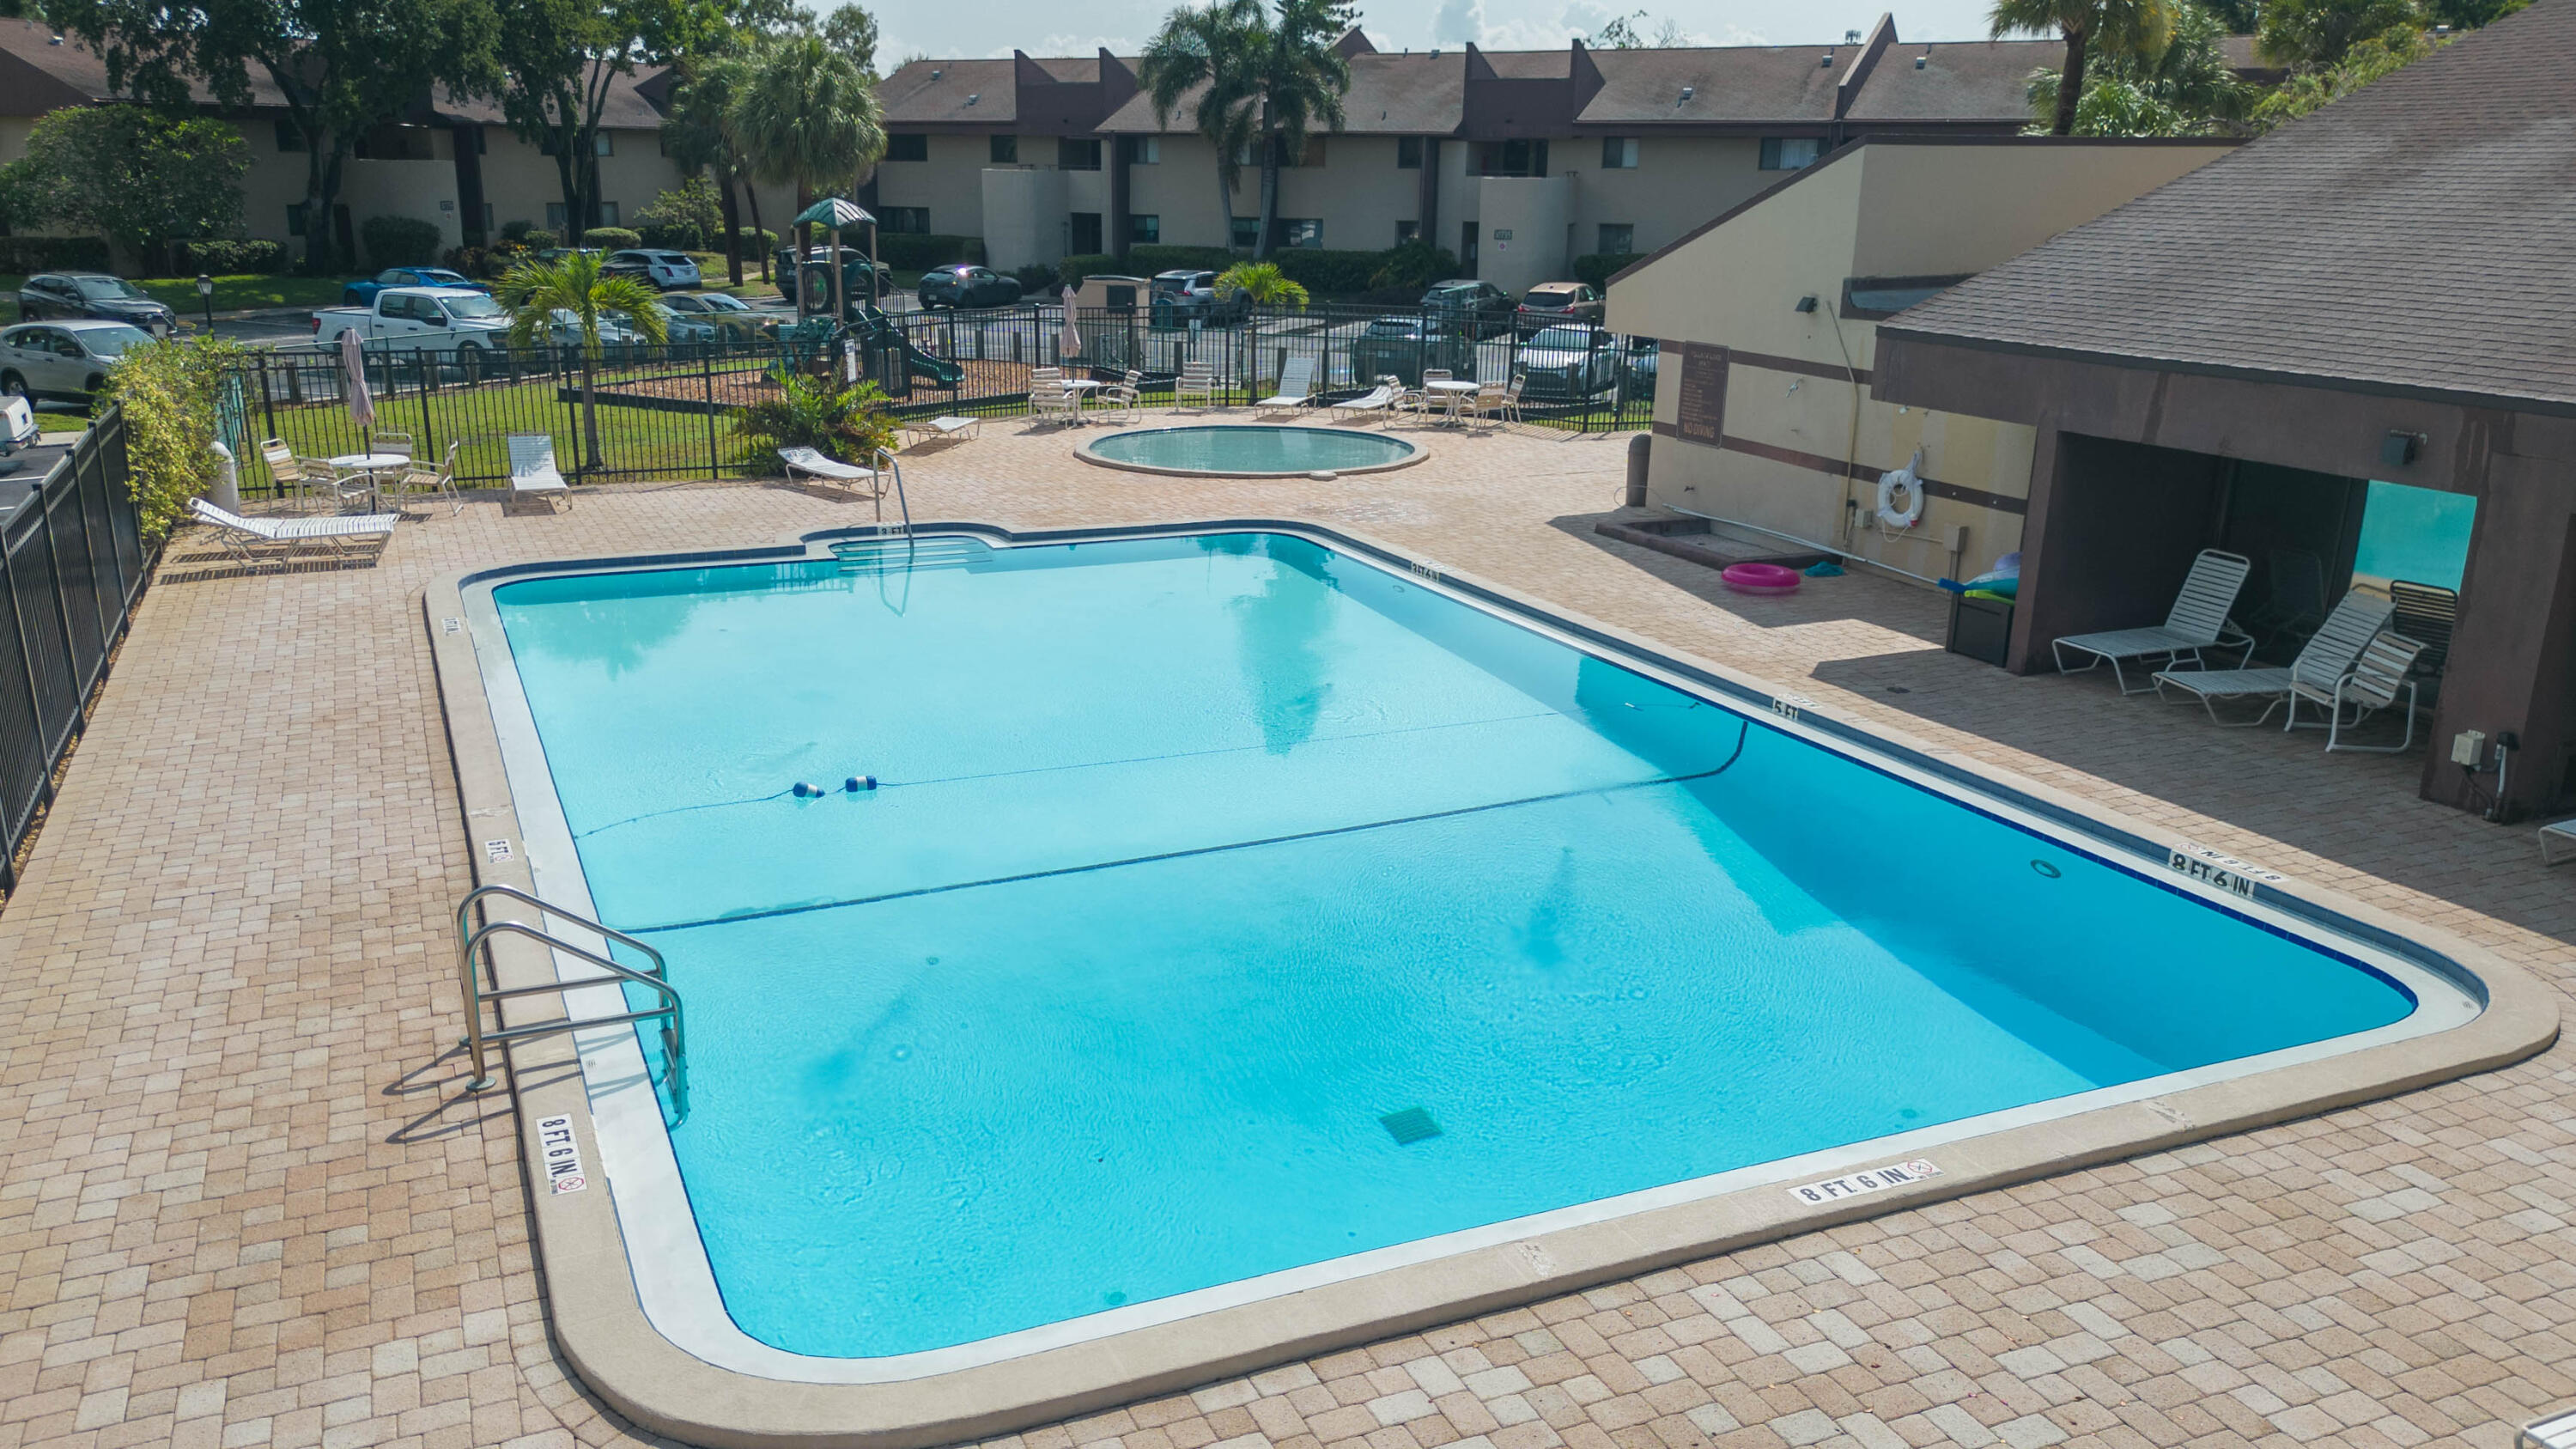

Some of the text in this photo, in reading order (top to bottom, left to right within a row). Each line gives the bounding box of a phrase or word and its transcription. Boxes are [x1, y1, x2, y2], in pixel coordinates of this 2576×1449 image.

[1774, 700, 1782, 714] 5
[1785, 703, 1798, 720] FT
[2172, 853, 2251, 896] 8 FT 6 IN
[542, 1118, 567, 1128] 8
[549, 1148, 574, 1158] 6
[1799, 1188, 1822, 1202] 8
[1856, 1174, 1879, 1189] 6
